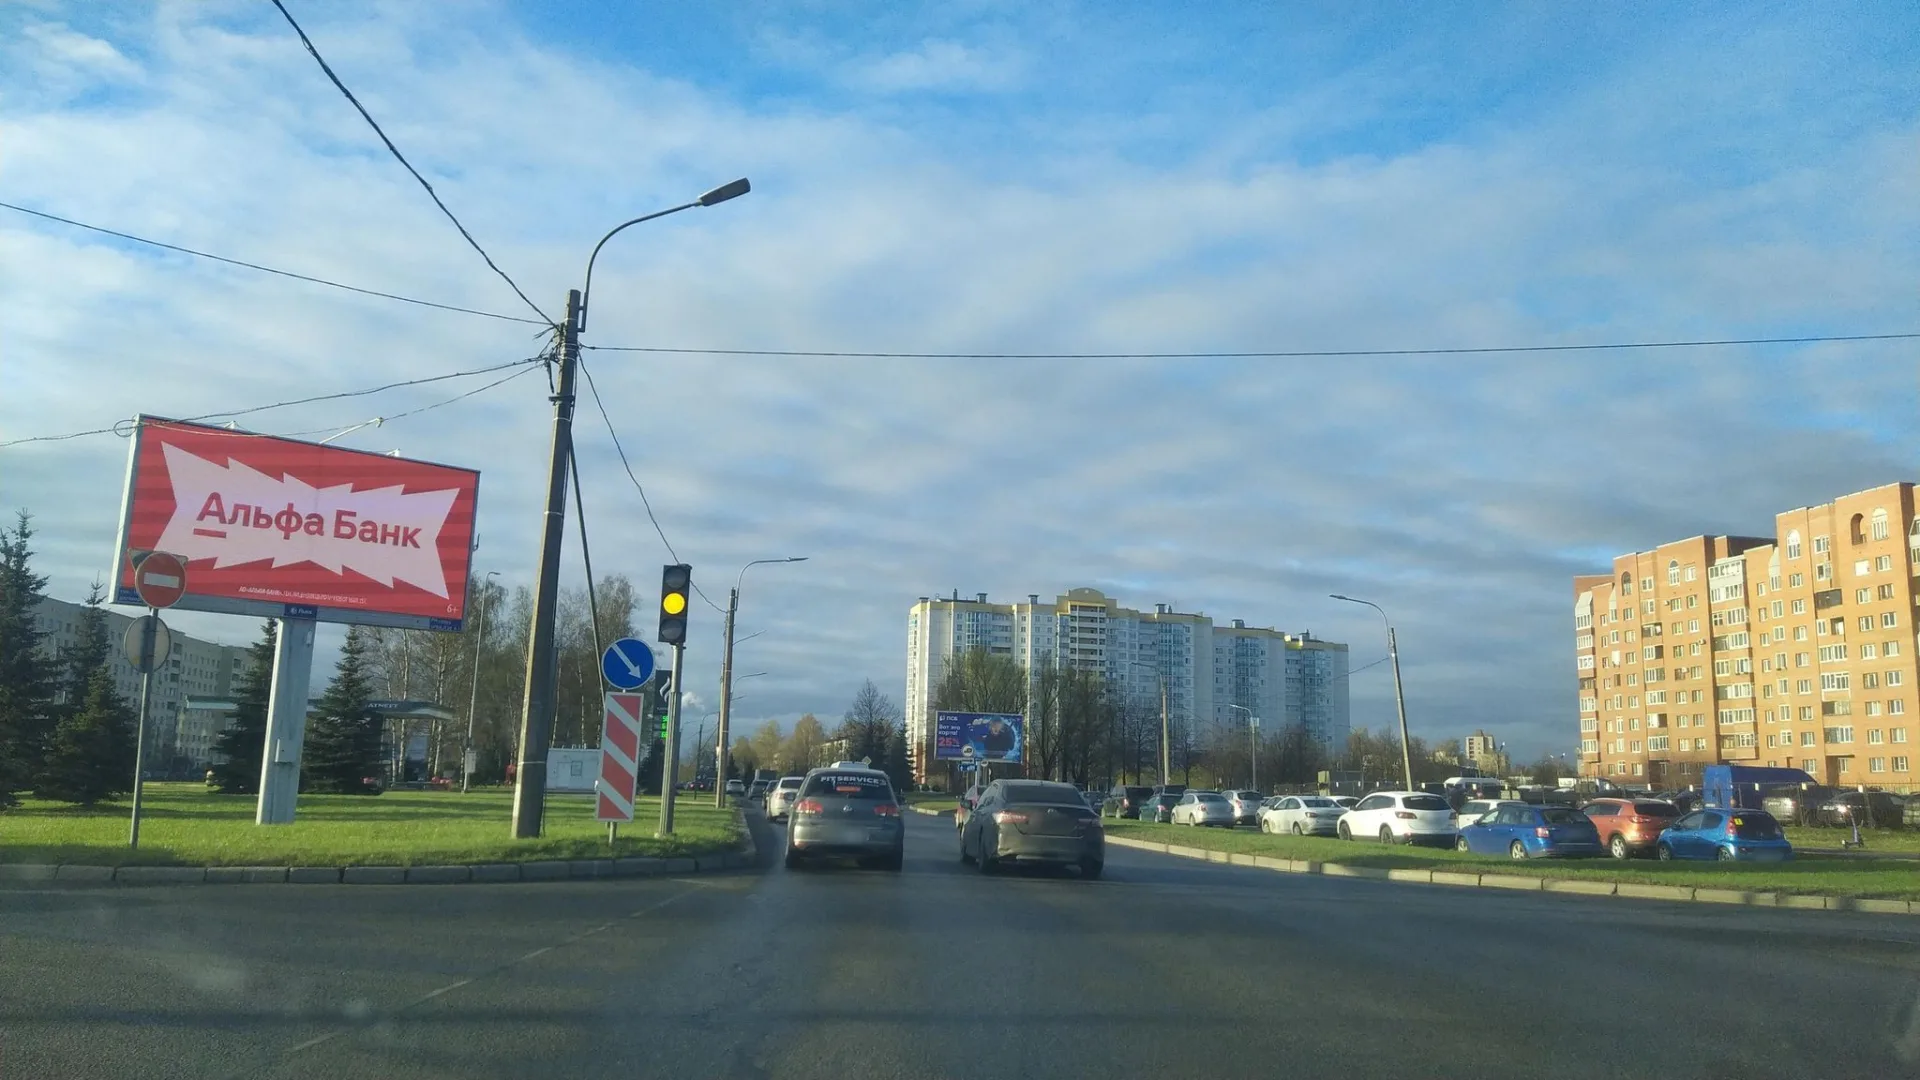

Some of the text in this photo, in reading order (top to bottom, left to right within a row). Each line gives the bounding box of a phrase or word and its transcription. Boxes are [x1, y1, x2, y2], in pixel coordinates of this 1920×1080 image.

[194, 491, 422, 549] Альфа Банк
[446, 603, 459, 613] 6+
